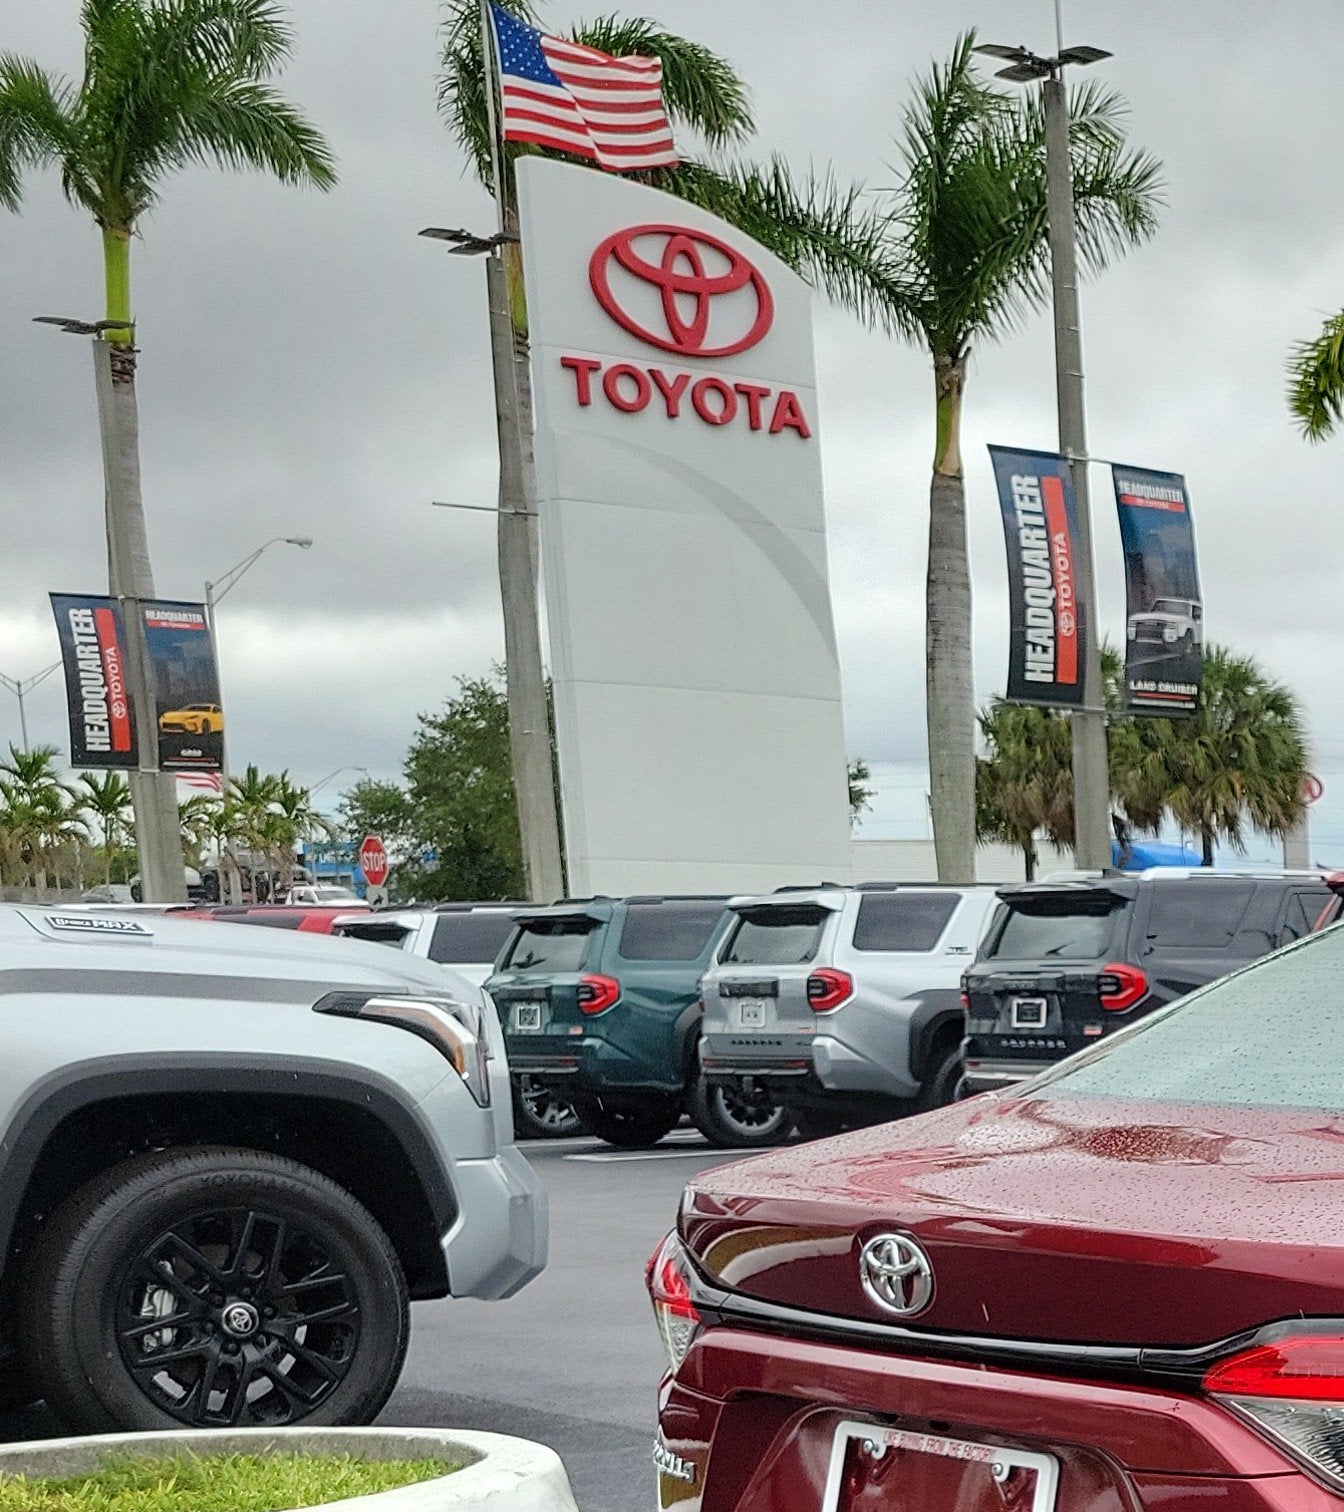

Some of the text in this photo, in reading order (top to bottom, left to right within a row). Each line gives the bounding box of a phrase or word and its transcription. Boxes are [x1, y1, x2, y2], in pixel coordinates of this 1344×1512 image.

[561, 356, 811, 439] TOYOTA
[1010, 474, 1057, 683] HEADQUARTER
[1052, 532, 1074, 608] TOYOTA
[69, 608, 112, 751] HEADQUARTER
[103, 646, 123, 700] TOYOTA
[362, 851, 386, 872] STOP
